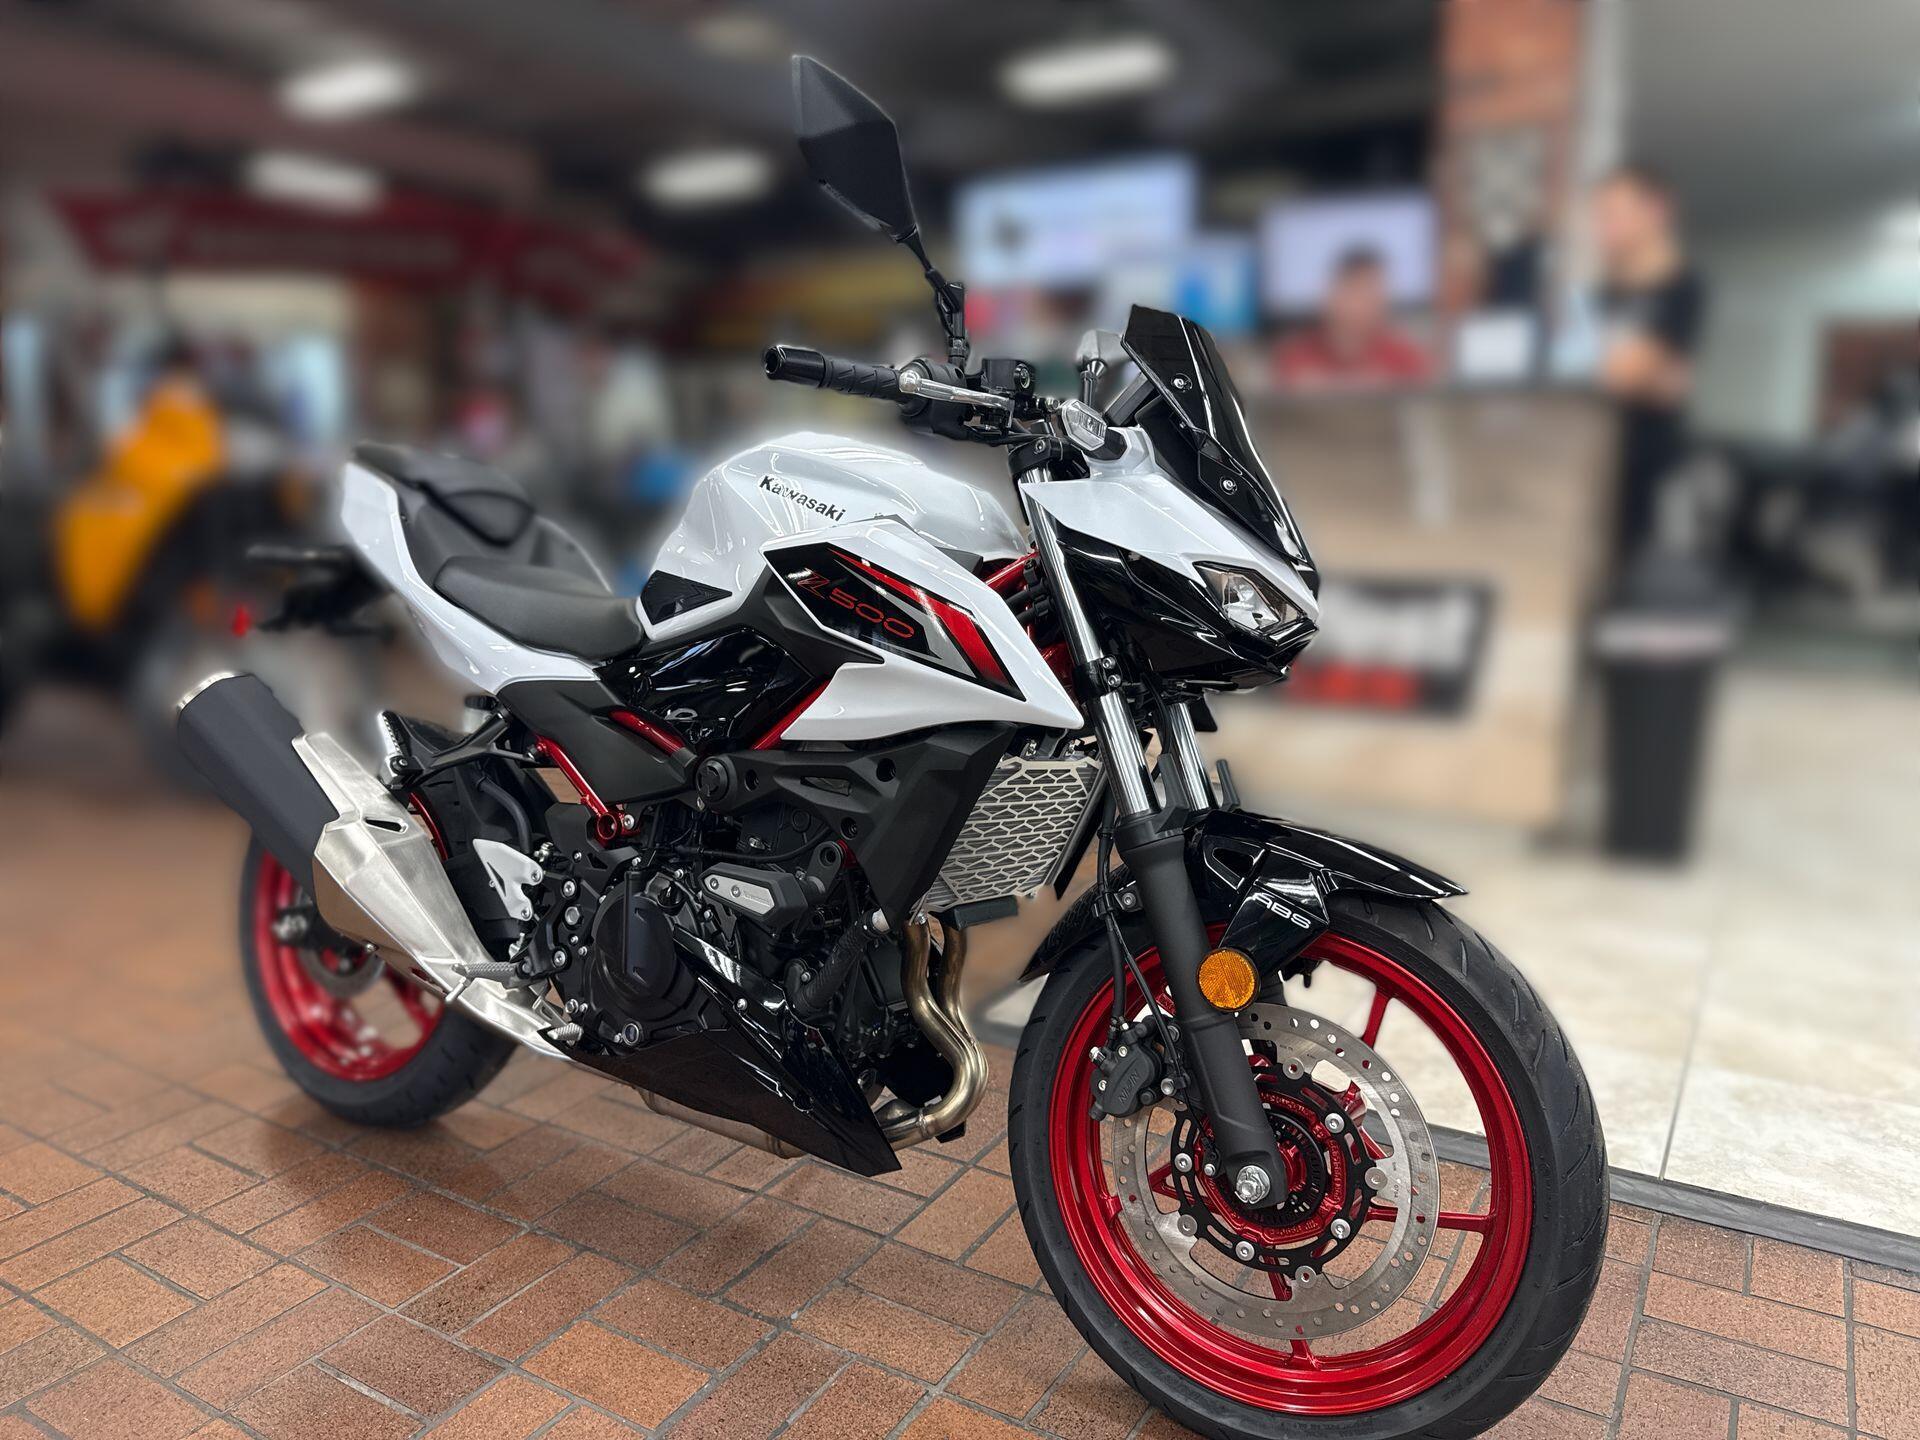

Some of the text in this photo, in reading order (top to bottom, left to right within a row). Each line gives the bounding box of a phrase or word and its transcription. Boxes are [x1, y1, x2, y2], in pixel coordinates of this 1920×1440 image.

[759, 475, 847, 521] Kawasaki
[1252, 892, 1312, 929] ABS
[1118, 1071, 1140, 1104] NIIN
